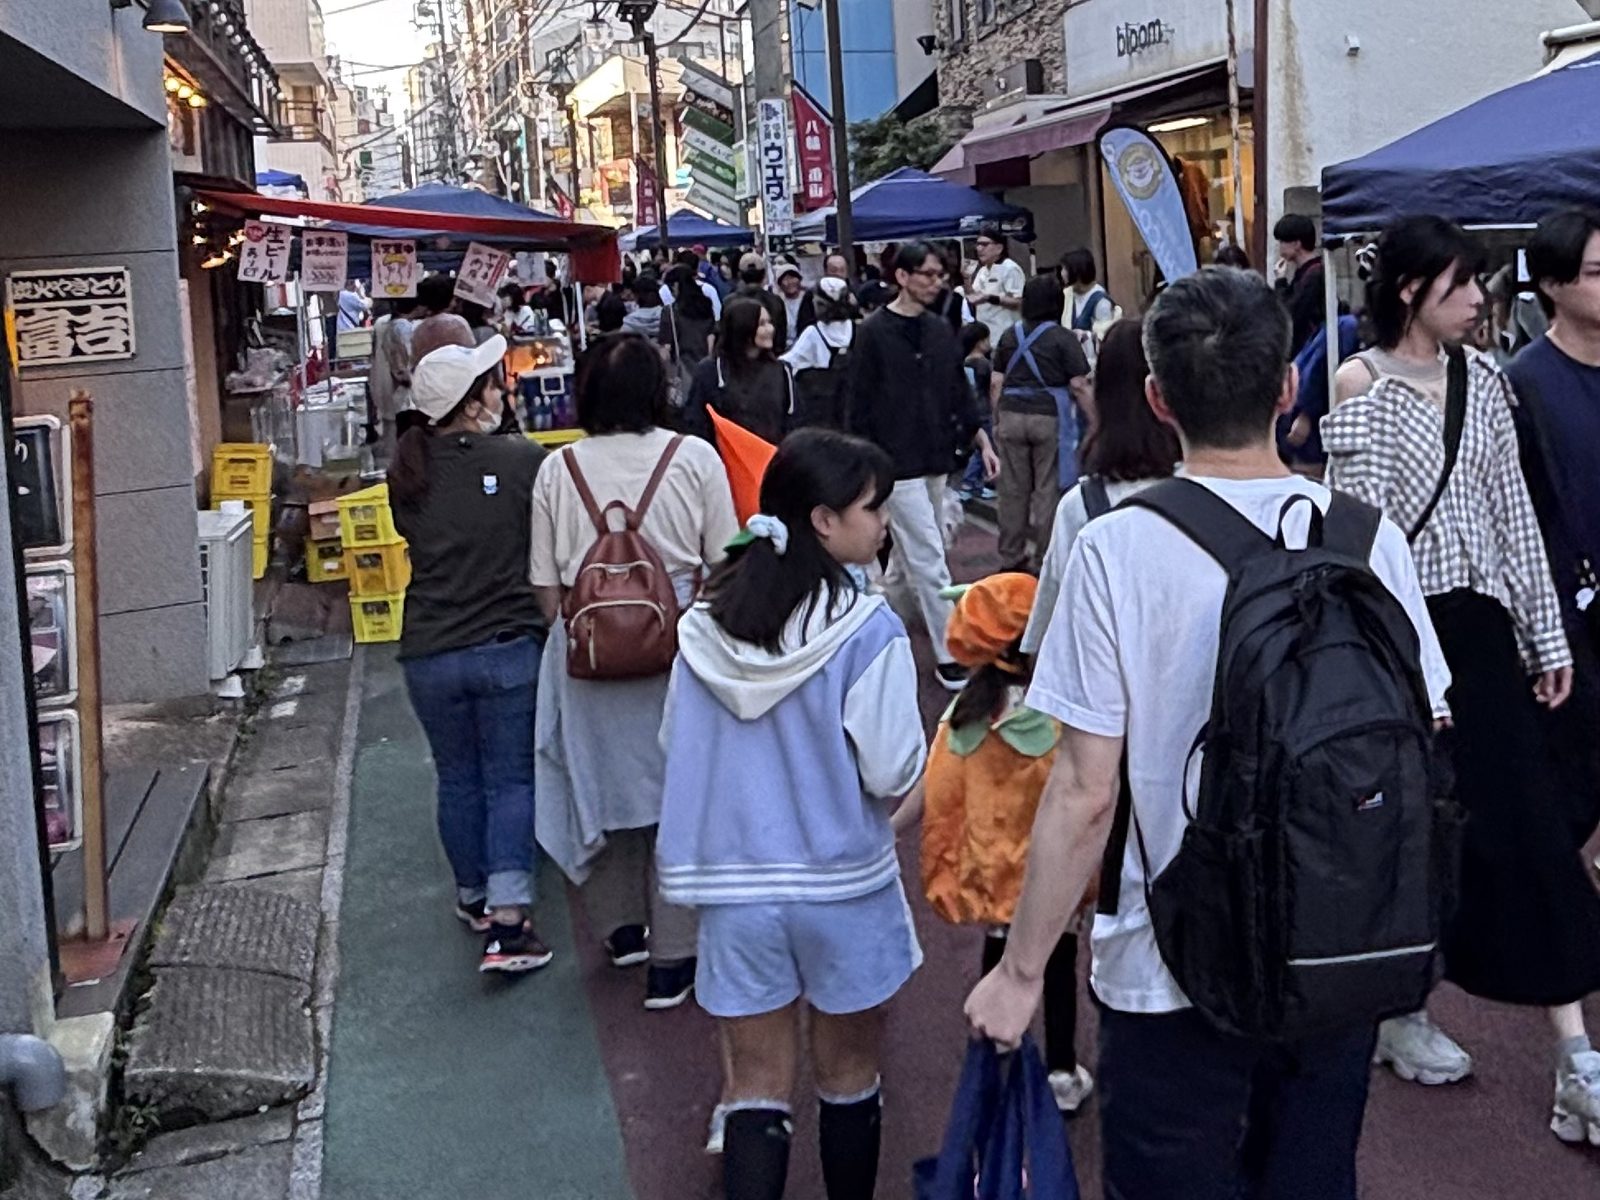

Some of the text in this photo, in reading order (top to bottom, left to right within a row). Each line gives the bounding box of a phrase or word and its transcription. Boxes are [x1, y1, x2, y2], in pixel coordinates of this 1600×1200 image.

[1116, 18, 1163, 57] bloom
[259, 225, 287, 281] 生ビール
[13, 276, 126, 300] 炭火やきとり
[16, 304, 129, 360] 富吉
